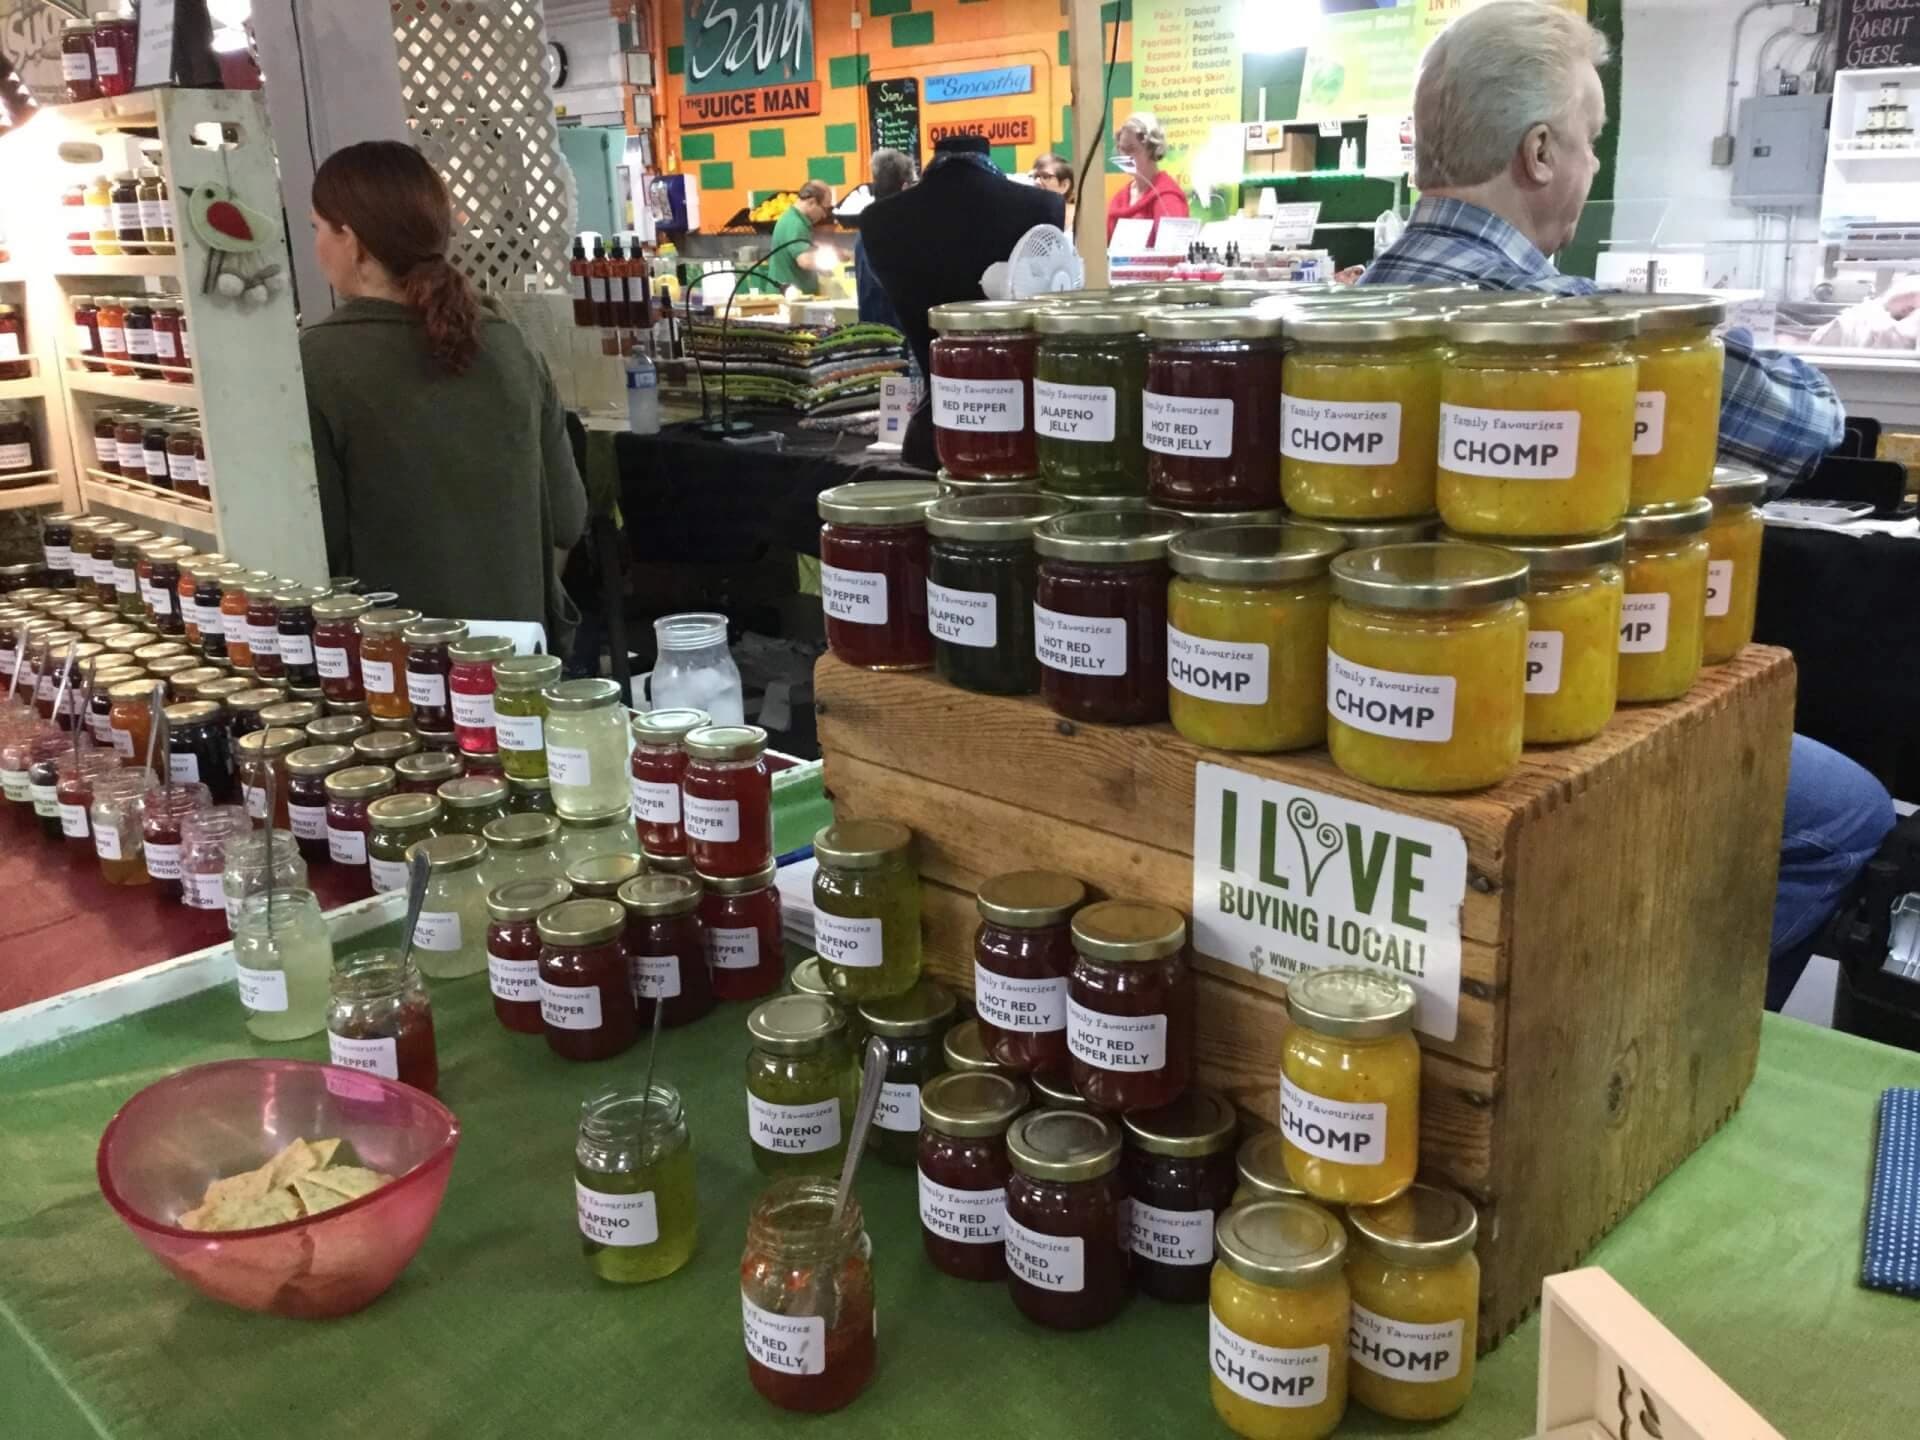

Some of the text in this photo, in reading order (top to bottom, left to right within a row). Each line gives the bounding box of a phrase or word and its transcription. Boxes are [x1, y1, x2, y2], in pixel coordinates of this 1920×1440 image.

[1848, 13, 1914, 47] RABBIT
[1846, 43, 1904, 65] GEESE
[686, 87, 810, 119] THE JUICE MAN
[988, 121, 1028, 139] JUICE
[942, 399, 1007, 413] RED PEPPER
[1041, 405, 1094, 421] JALAPENO
[1289, 403, 1388, 421] Family Favourites
[955, 413, 987, 426] JELLY
[1049, 420, 1079, 433] JELLY
[1151, 420, 1198, 436] HOT RED
[1452, 412, 1564, 432] Family Favourites
[1176, 437, 1213, 451] JELLY
[1291, 427, 1384, 454] CHOMP
[1454, 438, 1559, 467] CHOMP
[833, 590, 870, 605] PEPPER
[829, 601, 852, 614] JELLY
[936, 623, 961, 637] JELLY
[1044, 636, 1091, 654] HOT RED
[1194, 644, 1253, 661] Favourites
[1070, 655, 1105, 669] JELLY
[1171, 657, 1250, 692] CHOMP
[1335, 662, 1440, 695] Family Favourites
[1335, 688, 1435, 729] CHOMP
[690, 815, 724, 828] PEPPER
[1220, 789, 1238, 873] I
[1219, 881, 1426, 979] BUYING LOCAL!
[501, 977, 538, 987] PEPPER
[549, 1002, 584, 1015] PEPPER
[984, 992, 1037, 1012] HOT RED
[979, 1001, 1051, 1026] PEPPER JELLY
[1078, 1029, 1135, 1051] HOT RED
[1071, 1037, 1150, 1065] PEPPER JELLY
[338, 1055, 377, 1068] PEPPER
[1306, 1099, 1375, 1121] Favourites
[760, 1121, 822, 1137] JALAPENO
[1280, 1104, 1371, 1152] CHOMP
[772, 1138, 807, 1149] JELLY
[930, 1204, 986, 1224] HOT RED
[923, 1213, 1000, 1238] PEPPER JELLY
[1153, 1231, 1180, 1246] RED
[1025, 1252, 1048, 1268] RED
[1156, 1246, 1195, 1260] JELLY
[1027, 1267, 1064, 1285] JELLY
[1386, 1324, 1454, 1342] Favourites
[762, 1335, 788, 1352] RED
[1349, 1327, 1450, 1373] CHOMP
[766, 1350, 804, 1368] JELLY
[1250, 1347, 1319, 1367] Favourites
[1214, 1349, 1315, 1398] CHOMP
